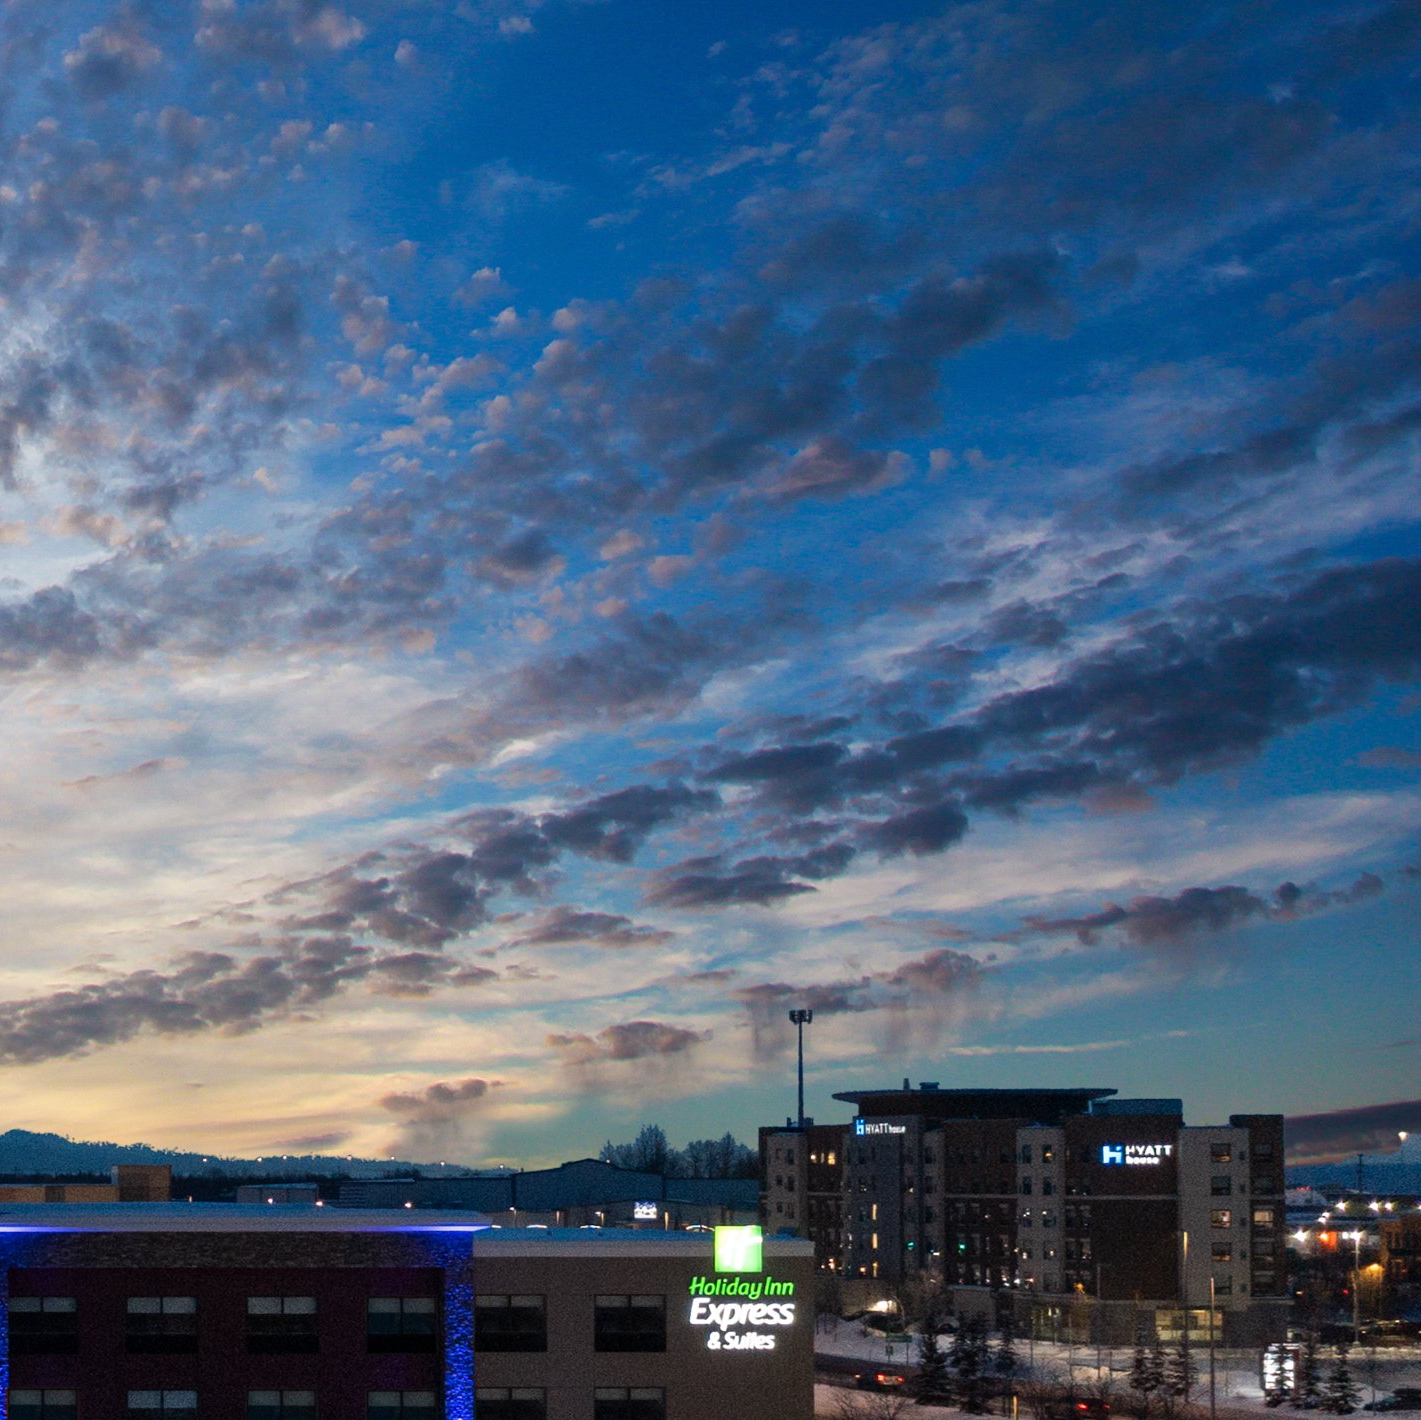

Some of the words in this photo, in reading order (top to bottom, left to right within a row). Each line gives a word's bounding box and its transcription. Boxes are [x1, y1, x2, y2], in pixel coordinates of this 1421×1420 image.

[865, 1122, 889, 1135] HYATT
[1125, 1144, 1173, 1156] HYATT
[689, 1276, 762, 1300] Holiday
[764, 1276, 795, 1296] Inn
[689, 1297, 796, 1331] Express
[706, 1331, 721, 1350] &
[722, 1331, 776, 1350] Suites
